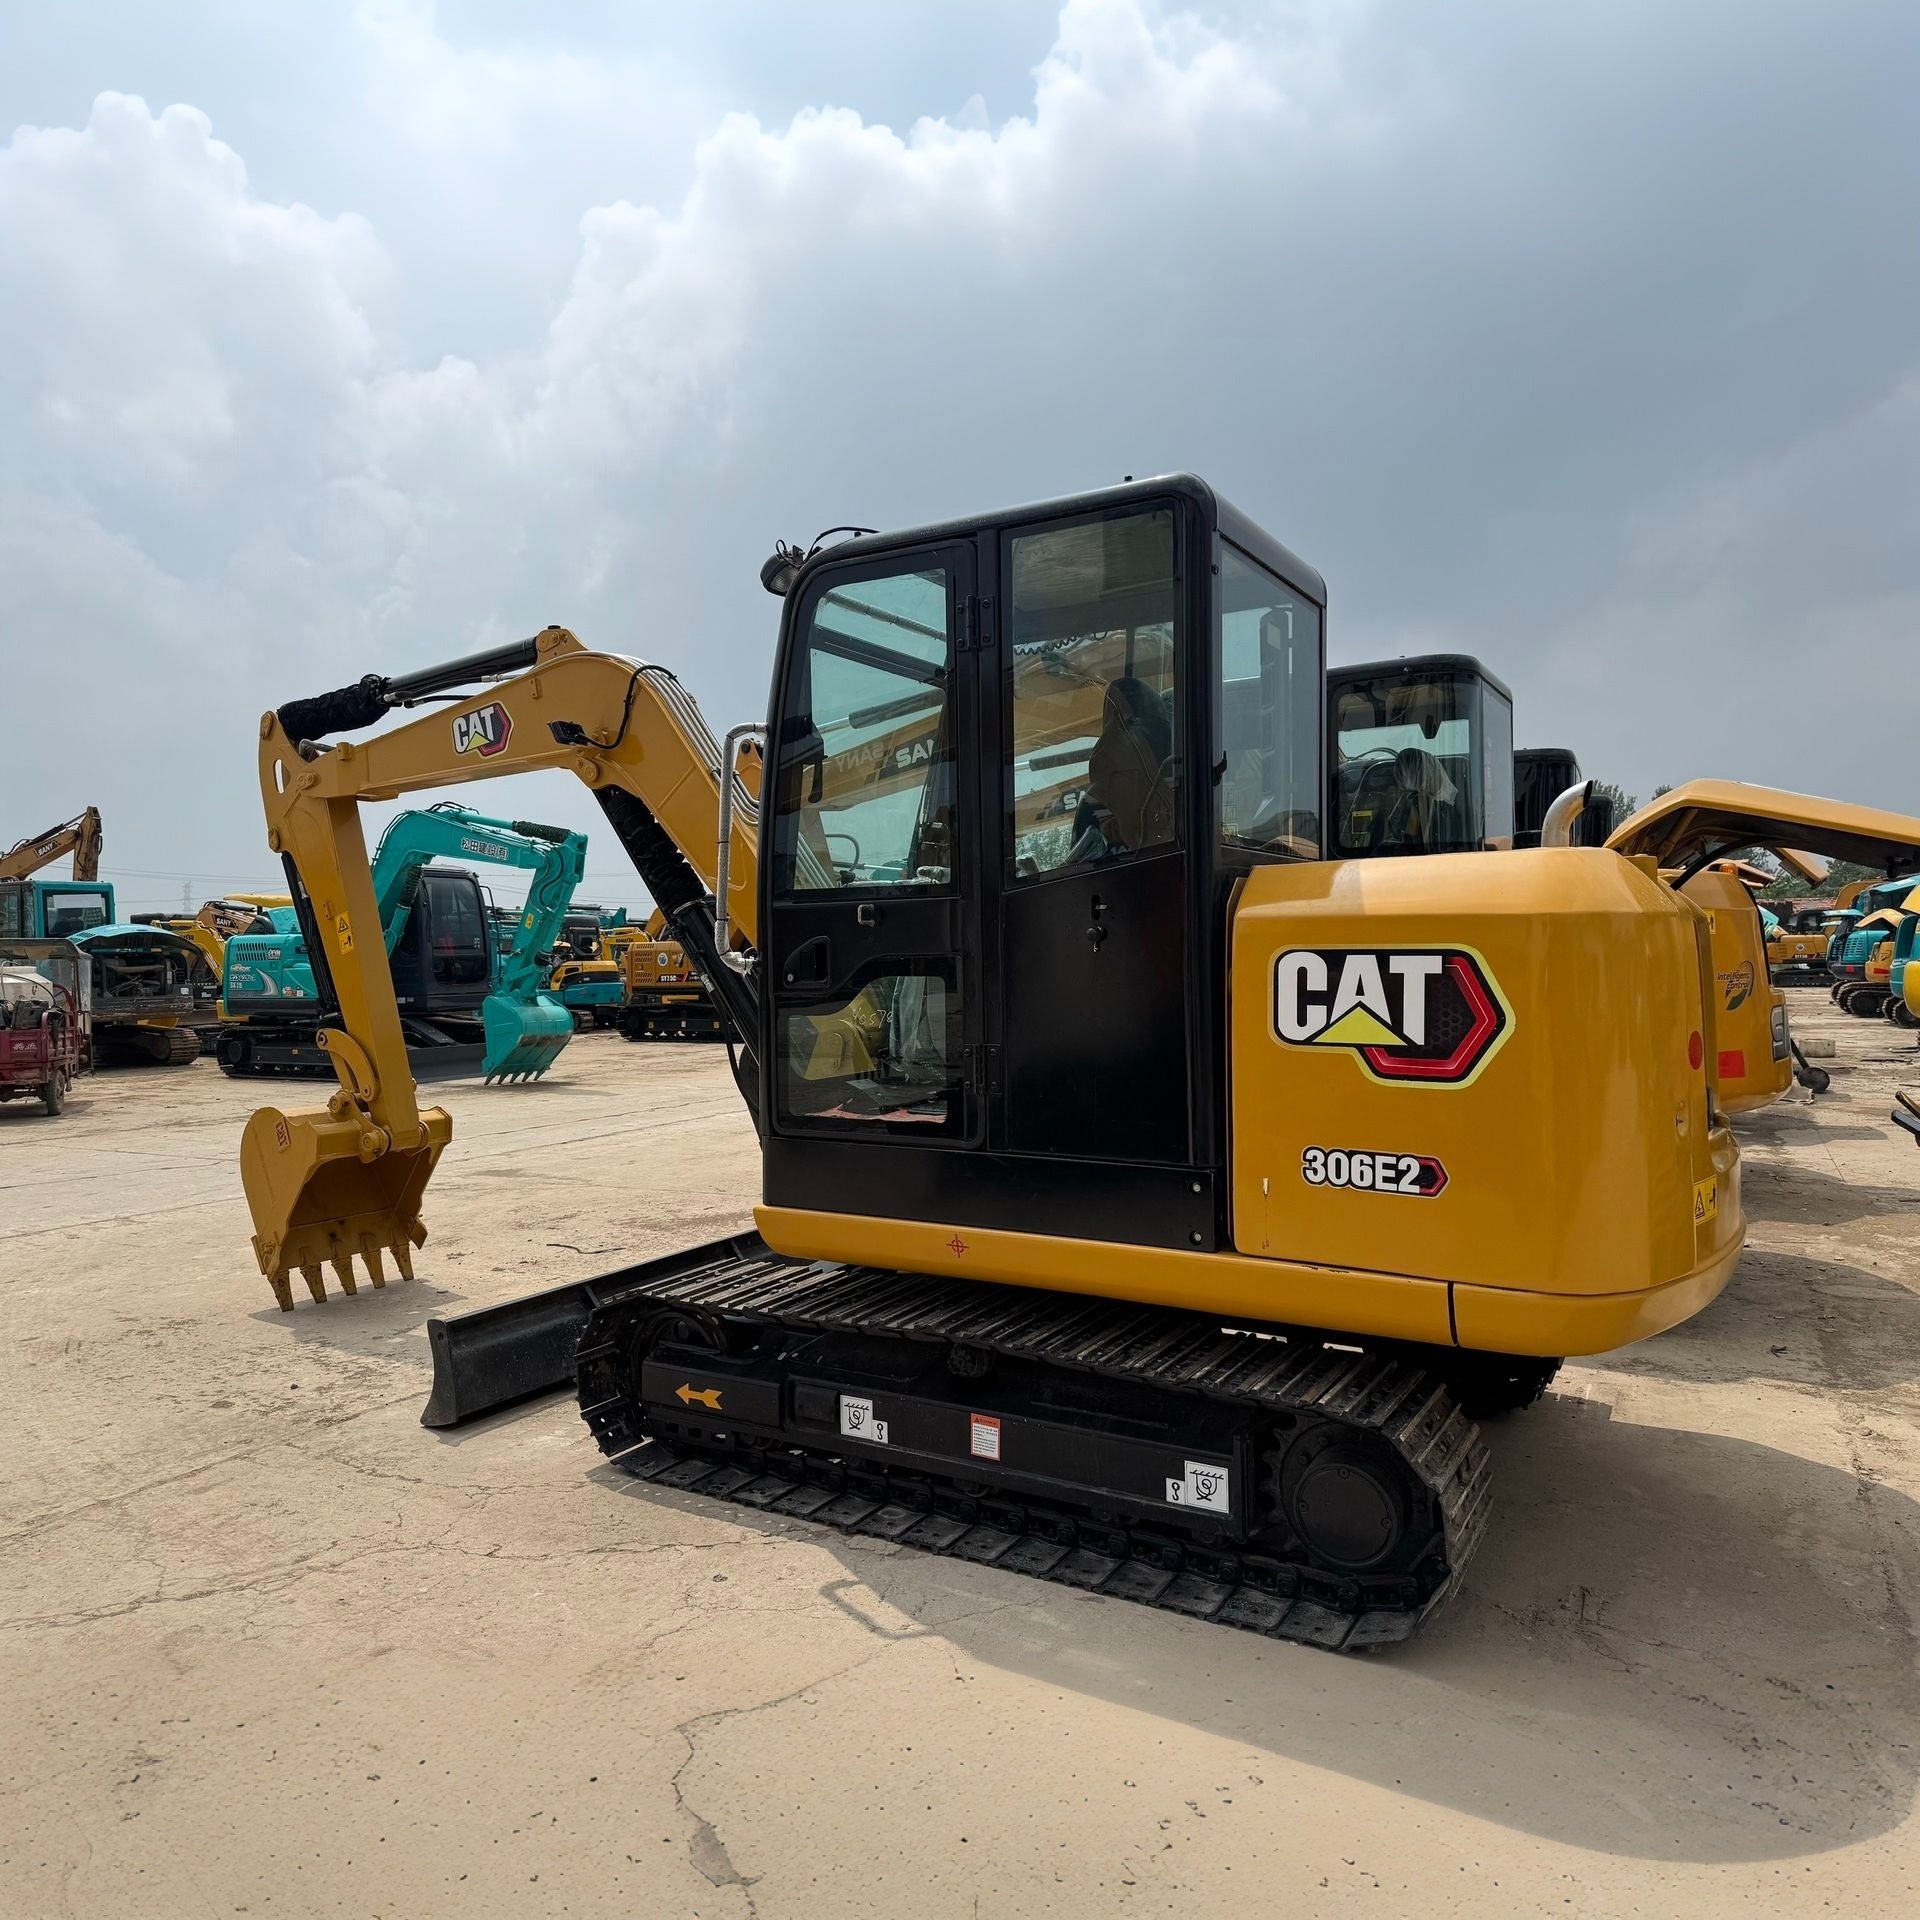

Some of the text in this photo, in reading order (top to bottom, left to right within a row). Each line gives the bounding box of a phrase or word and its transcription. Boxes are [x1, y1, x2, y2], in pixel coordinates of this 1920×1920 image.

[453, 706, 495, 753] CAT
[895, 739, 935, 769] SA
[38, 842, 53, 855] SANY
[216, 918, 231, 926] SANY
[1717, 970, 1750, 981] Intelligent
[1278, 952, 1443, 1046] CAT
[1304, 1149, 1421, 1194] 306E2
